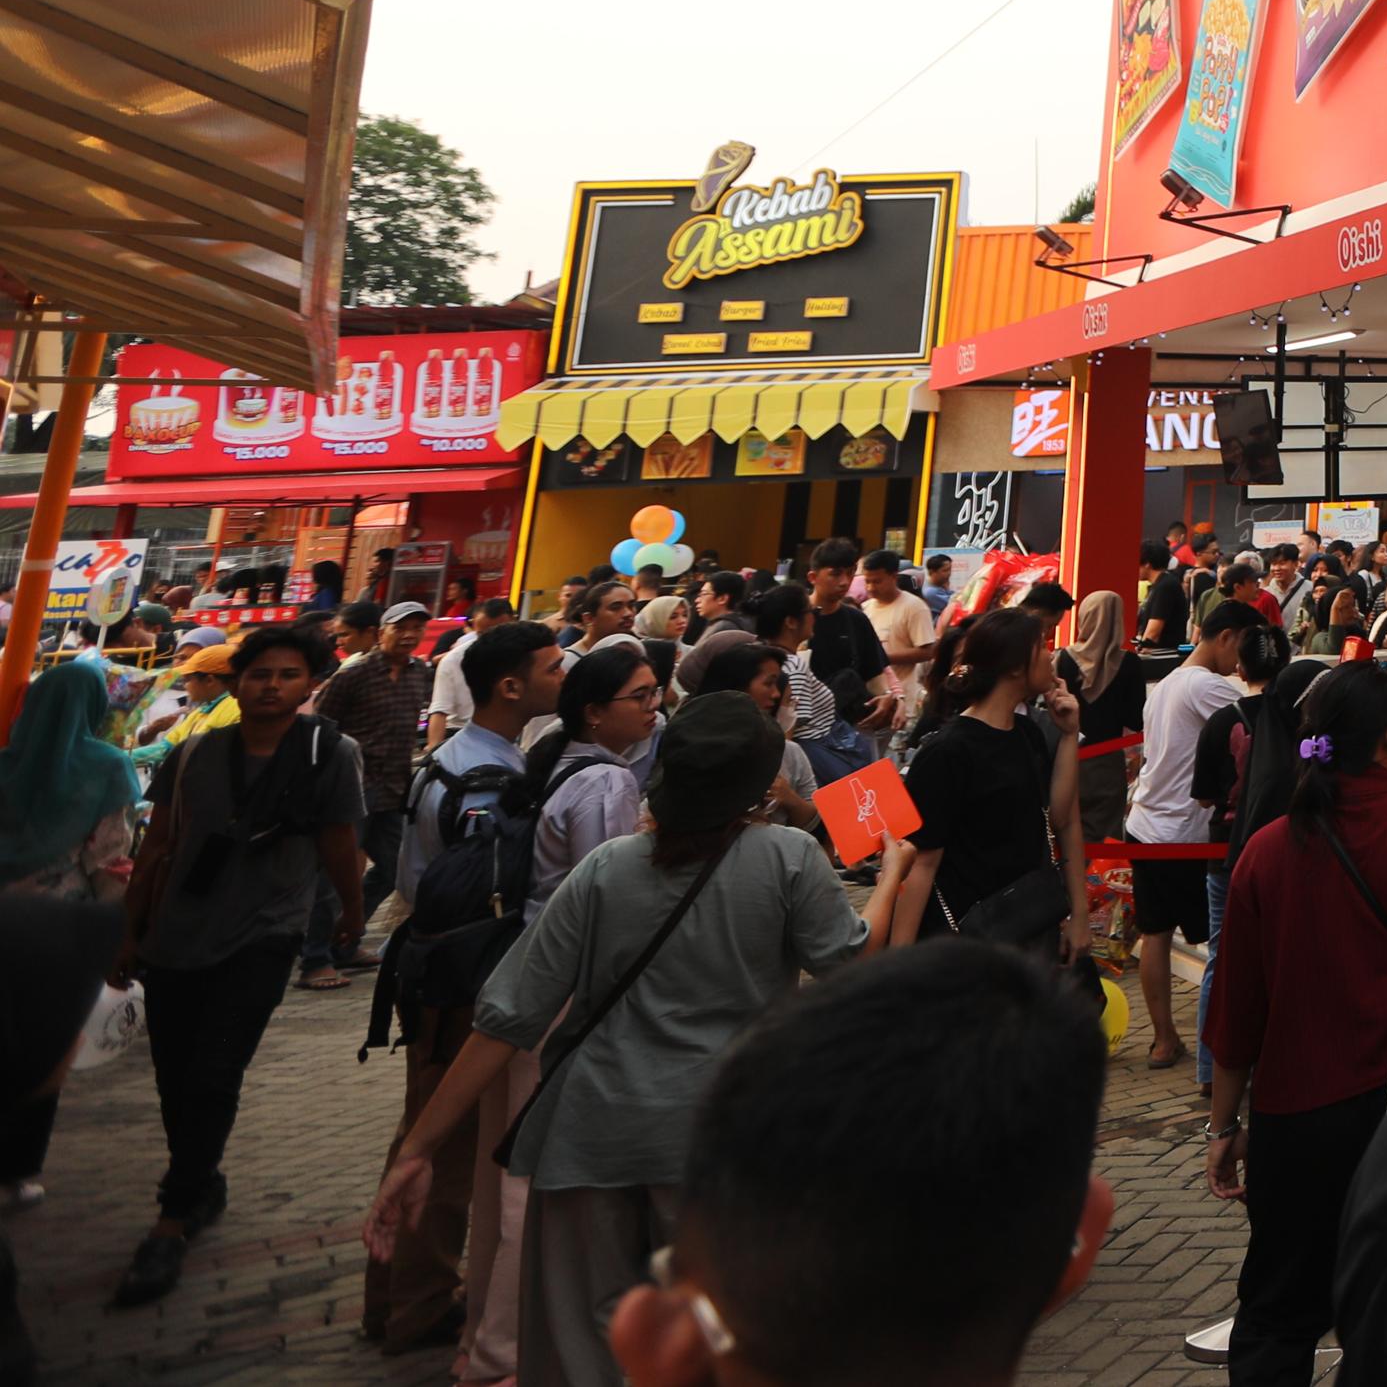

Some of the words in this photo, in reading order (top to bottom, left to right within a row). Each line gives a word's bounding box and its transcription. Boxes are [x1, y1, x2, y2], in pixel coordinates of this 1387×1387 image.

[722, 171, 833, 228] Kebab
[668, 200, 858, 283] Assami
[1337, 218, 1383, 272] Oishi
[1082, 303, 1108, 339] Oishi
[1042, 439, 1066, 452] 1953
